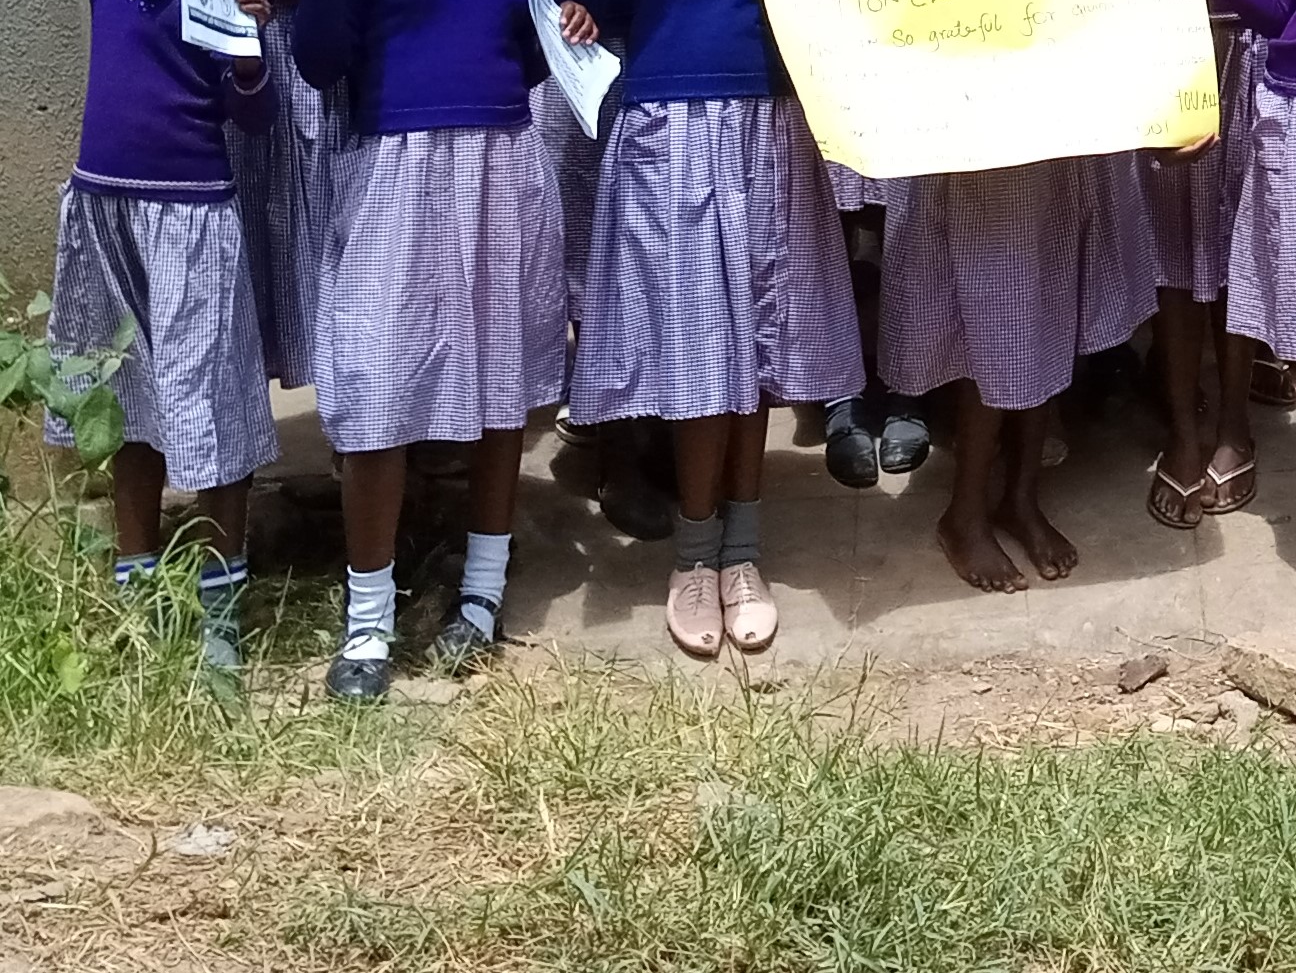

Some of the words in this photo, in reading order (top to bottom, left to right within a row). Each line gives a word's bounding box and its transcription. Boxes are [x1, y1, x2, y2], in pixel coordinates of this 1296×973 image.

[929, 13, 1002, 52] grateful
[1020, 2, 1055, 37] for
[1175, 89, 1199, 113] YOU
